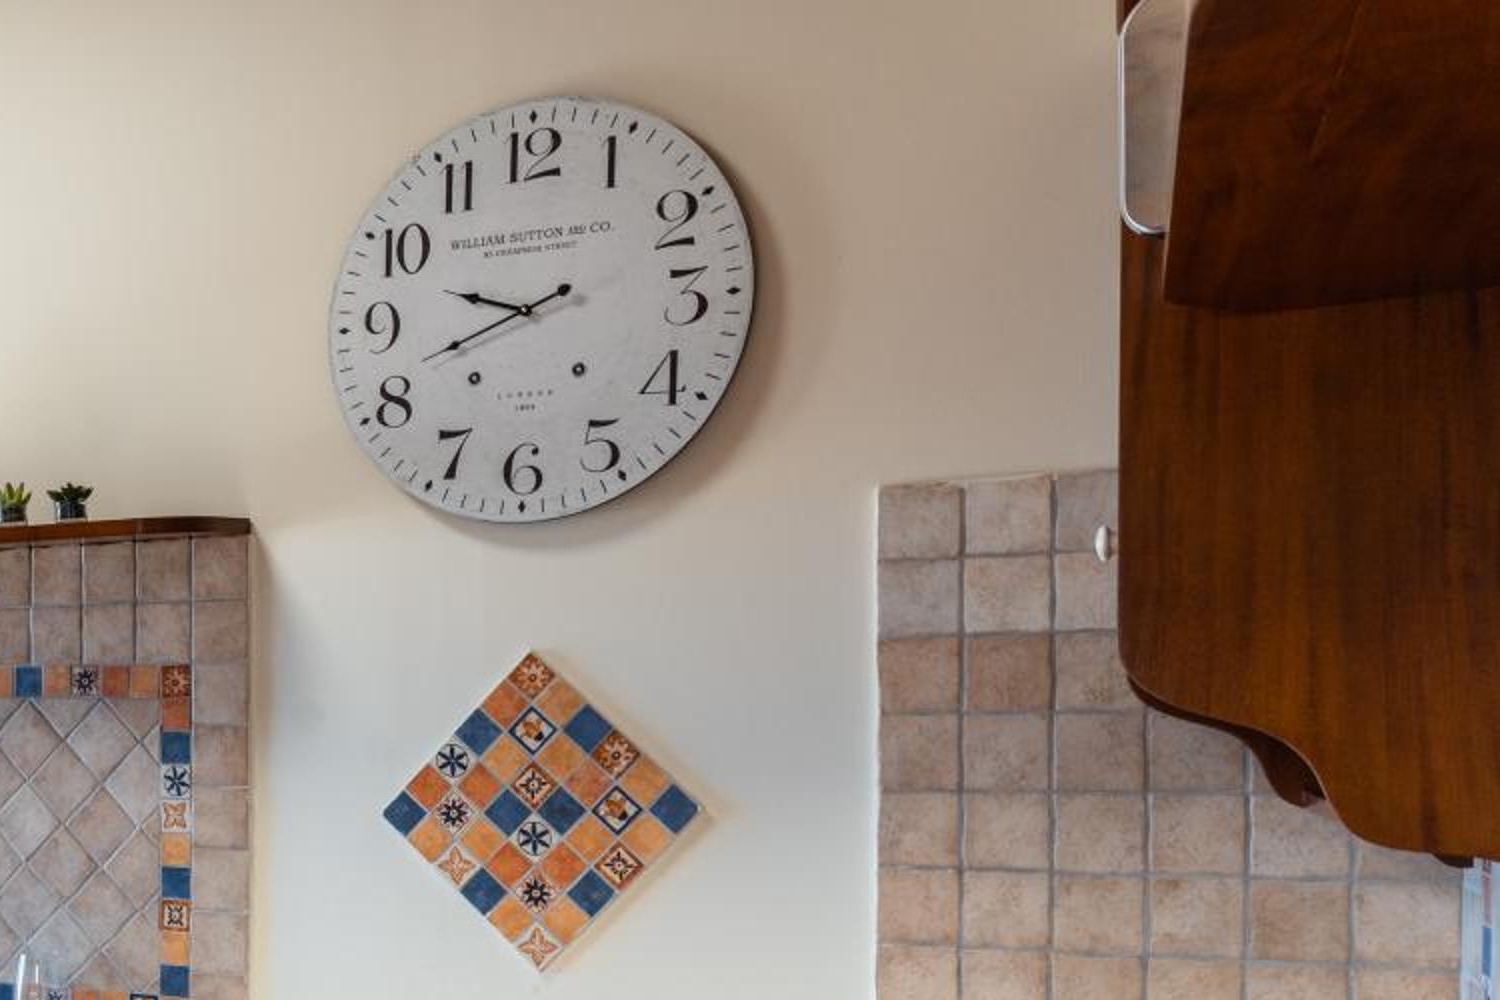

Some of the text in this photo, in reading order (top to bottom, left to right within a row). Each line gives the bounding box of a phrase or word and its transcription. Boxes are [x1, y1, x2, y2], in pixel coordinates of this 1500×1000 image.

[505, 126, 563, 185] 12
[602, 134, 618, 189] 1
[442, 159, 474, 215] 11
[451, 233, 505, 251] WILLIAM
[509, 225, 563, 243] SUTTON
[653, 189, 700, 251] 2
[383, 222, 431, 276] 10
[663, 265, 710, 327] 3
[363, 301, 401, 355] 9
[375, 375, 413, 429] 8
[637, 348, 688, 407] 4
[438, 426, 474, 481] 7
[502, 442, 544, 496] 6
[579, 417, 622, 474] 5
